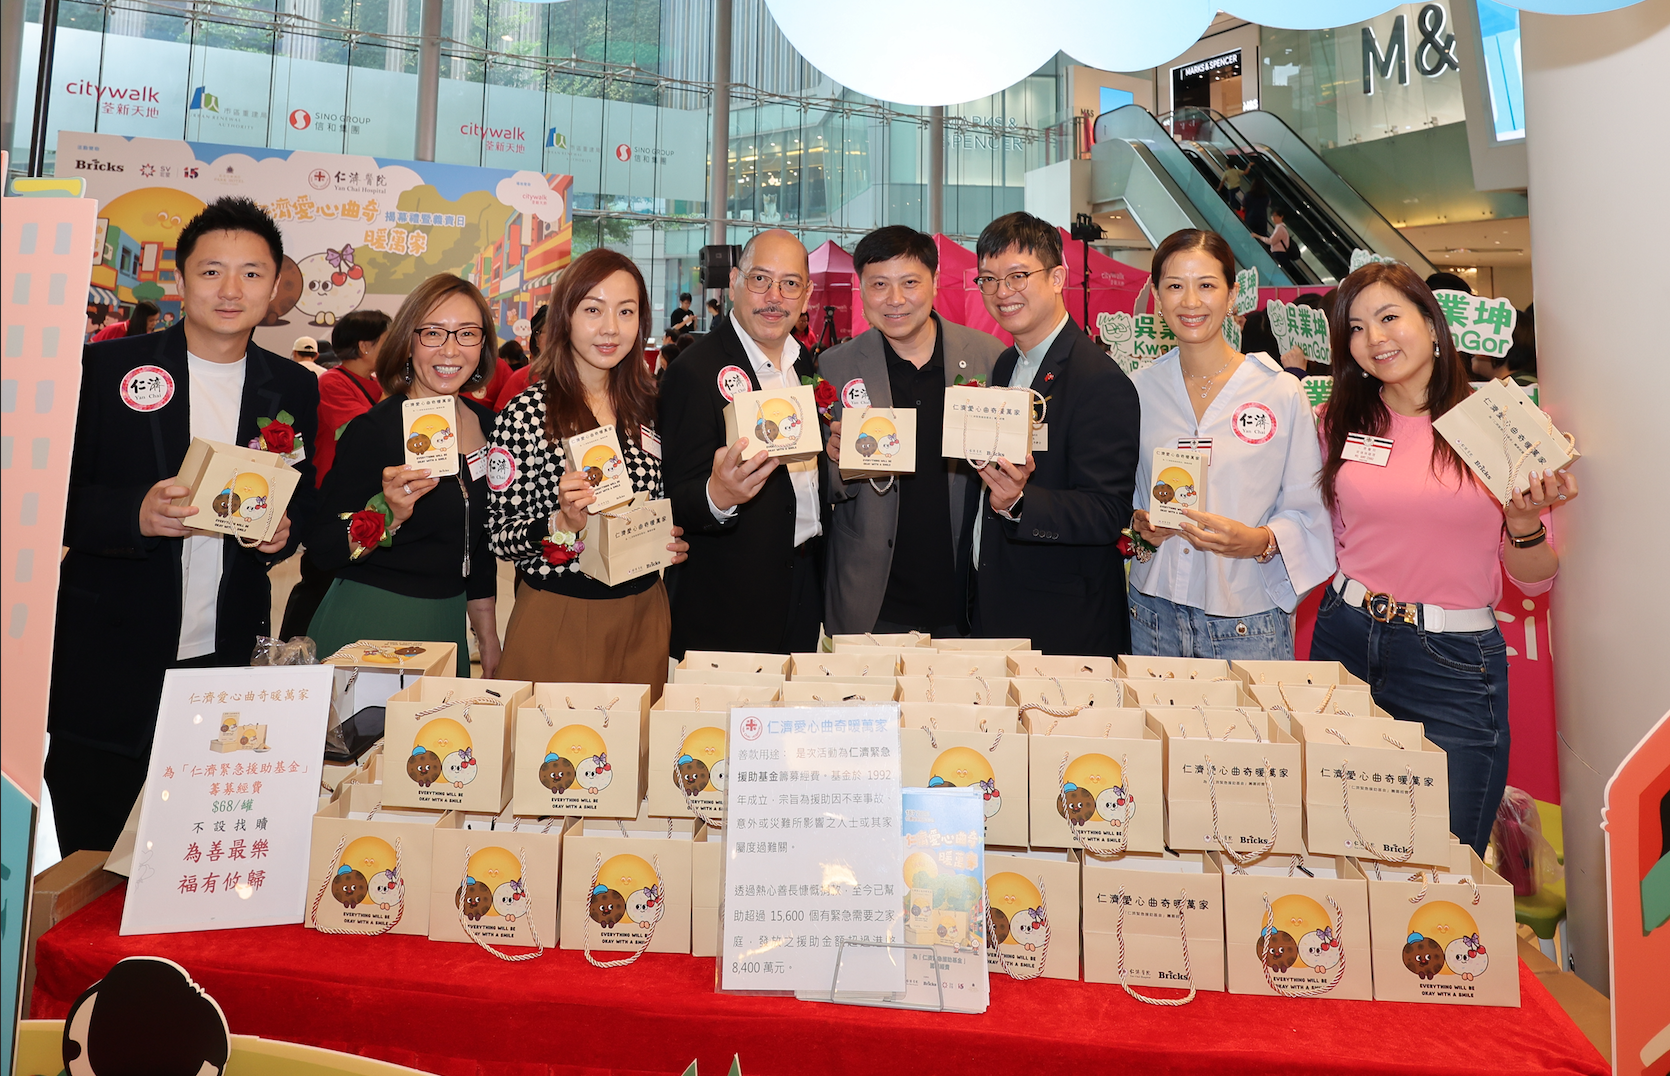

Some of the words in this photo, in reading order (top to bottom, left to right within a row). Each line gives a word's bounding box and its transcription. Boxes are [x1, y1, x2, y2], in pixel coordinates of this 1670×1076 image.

[1185, 63, 1205, 76] MARKS
[1209, 54, 1238, 70] SPENCER
[66, 79, 160, 103] citywalk
[101, 102, 160, 119] 荃新天地
[315, 112, 338, 121] SINO
[339, 114, 371, 125] GROUP
[314, 121, 361, 135] 信和集團
[460, 122, 526, 142] citywalk
[485, 140, 526, 154] 荃新天地
[634, 146, 651, 154] SINO
[651, 148, 675, 157] GROUP
[75, 158, 124, 172] Bricks
[334, 171, 388, 187] 仁濟醫院
[362, 187, 387, 195] Hospital
[363, 227, 428, 257] 暖萬家
[1286, 306, 1328, 345] 吳業坤
[130, 376, 165, 393] 仁濟
[724, 374, 747, 389] 仁濟
[148, 392, 162, 400] Chai
[1239, 413, 1270, 430] 仁濟
[489, 458, 510, 475] 仁濟
[1474, 460, 1492, 480] Bricks
[188, 688, 310, 705] 仁濟愛心曲奇暖萬家
[767, 718, 888, 735] 仁濟愛心曲奇暖萬家
[796, 746, 891, 759] 是次活動為仁濟緊急
[162, 760, 309, 779] 為「仁濟緊急援助基金」
[867, 769, 892, 781] 1992
[1320, 767, 1434, 787] 仁濟愛心曲奇暖萬家
[209, 780, 263, 796] 籌募經費
[211, 798, 254, 813] $68/罐
[736, 817, 893, 829] 意外或災難所影響之人士或其家
[1240, 835, 1268, 845] Bricks
[183, 838, 269, 863] 為善最樂
[1383, 844, 1414, 854] Brick
[733, 909, 766, 922] 助超過
[770, 909, 805, 923] 15,600
[809, 909, 895, 922] 個有緊急需要之家
[732, 961, 761, 975] 8,400
[1158, 970, 1188, 981] Bricks
